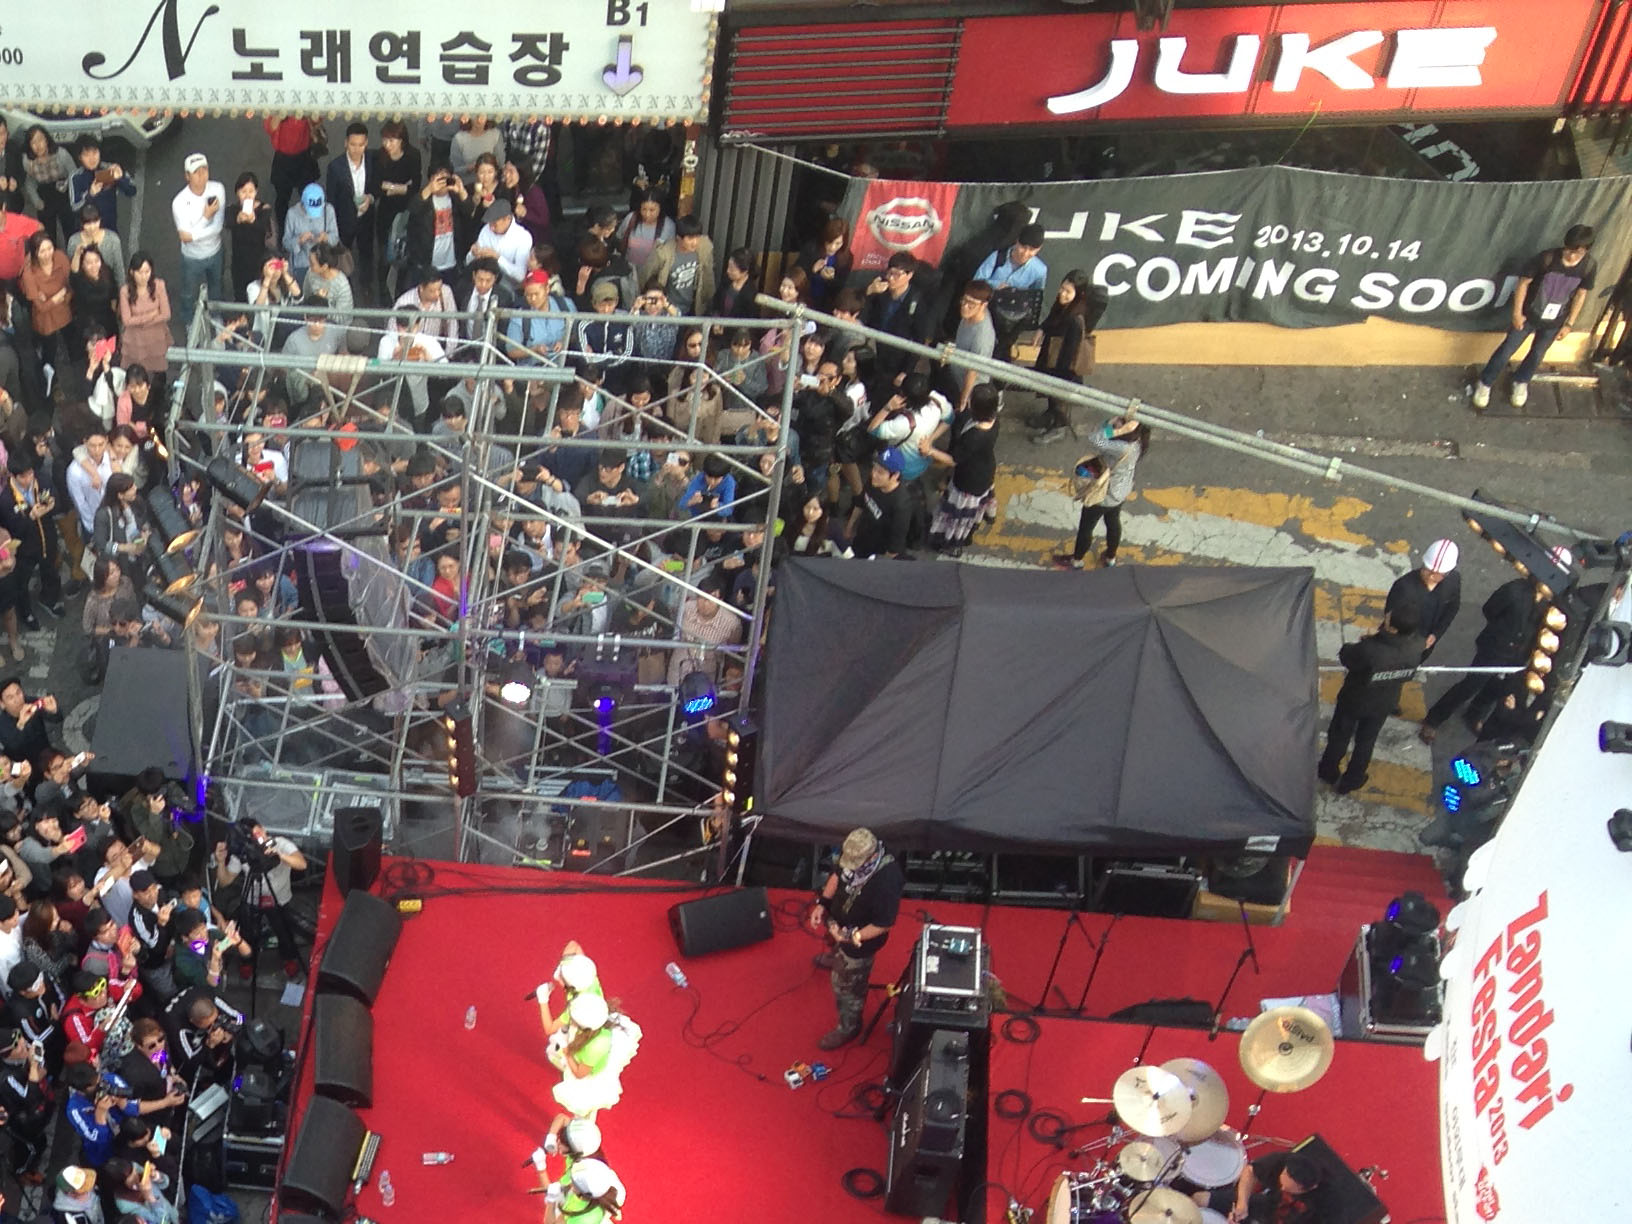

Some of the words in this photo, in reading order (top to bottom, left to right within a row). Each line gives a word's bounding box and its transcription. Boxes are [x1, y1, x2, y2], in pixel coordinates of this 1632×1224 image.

[606, 0, 649, 27] B1
[231, 28, 570, 87] 노래연습장
[1047, 27, 1497, 114] JUKE
[873, 213, 935, 232] NISSAN
[1029, 206, 1243, 249] UKE
[1254, 224, 1423, 262] 2013.10.14
[1094, 252, 1340, 303] COMING
[1371, 669, 1416, 682] SECURITY
[1472, 931, 1504, 1120] Festa
[1487, 1096, 1510, 1167] 2013
